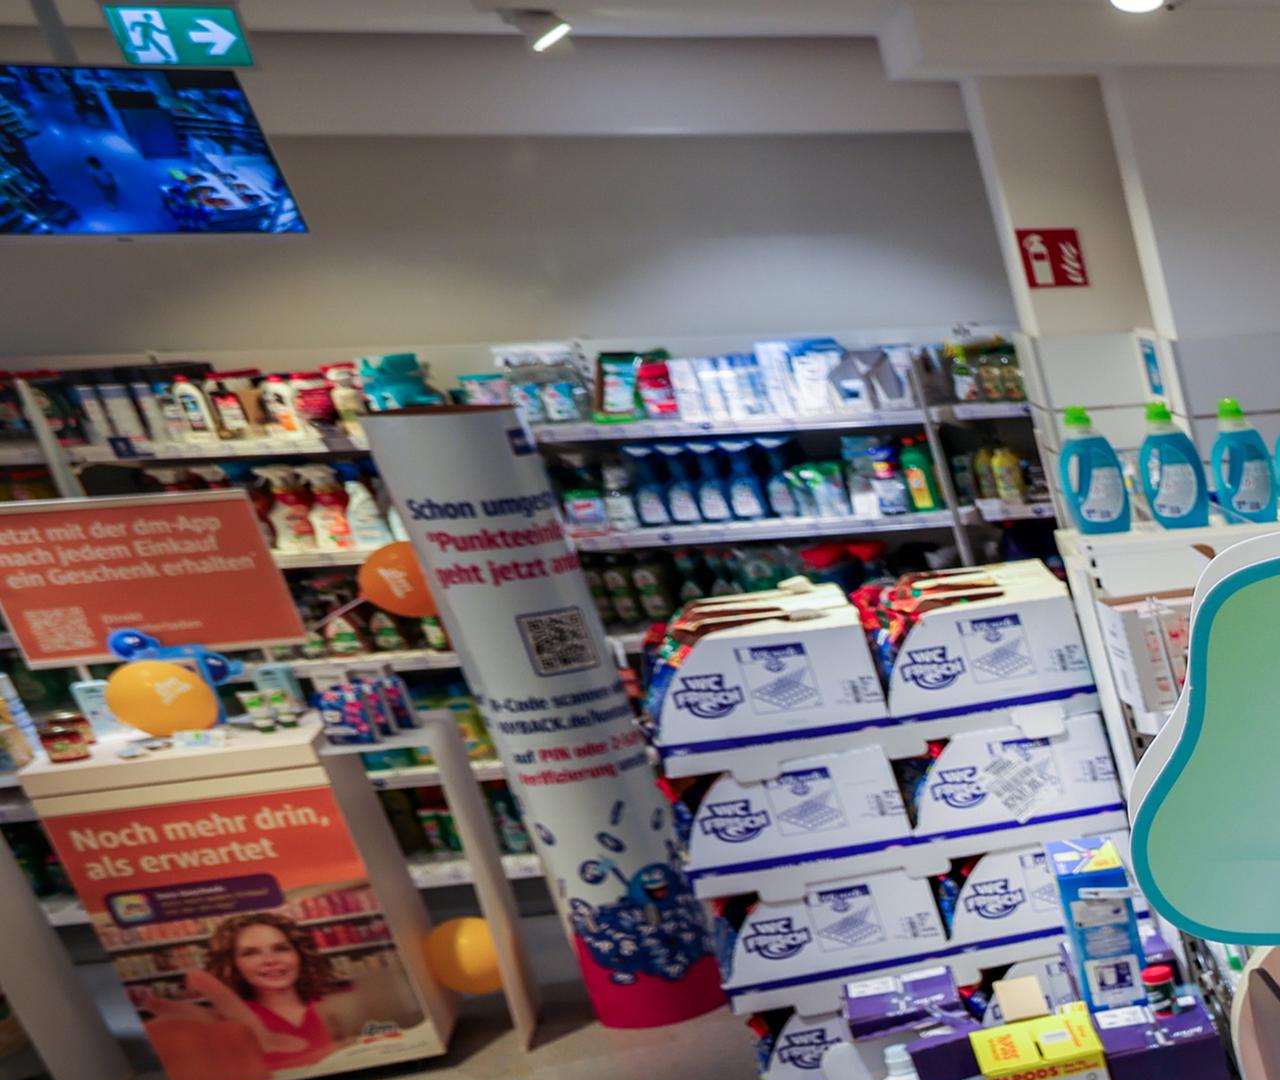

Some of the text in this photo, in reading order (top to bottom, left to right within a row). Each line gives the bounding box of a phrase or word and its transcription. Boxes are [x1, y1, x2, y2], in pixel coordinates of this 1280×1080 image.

[406, 499, 478, 520] Schon
[0, 513, 222, 547] etzt mit der dm-App
[57, 541, 132, 567] jedem
[134, 534, 219, 556] Einkauf
[6, 571, 46, 589] ein
[48, 560, 160, 586] Geschenk
[487, 558, 549, 587] jetzt
[70, 803, 331, 852] Noch mehr drin,
[87, 838, 279, 881] als erwartet
